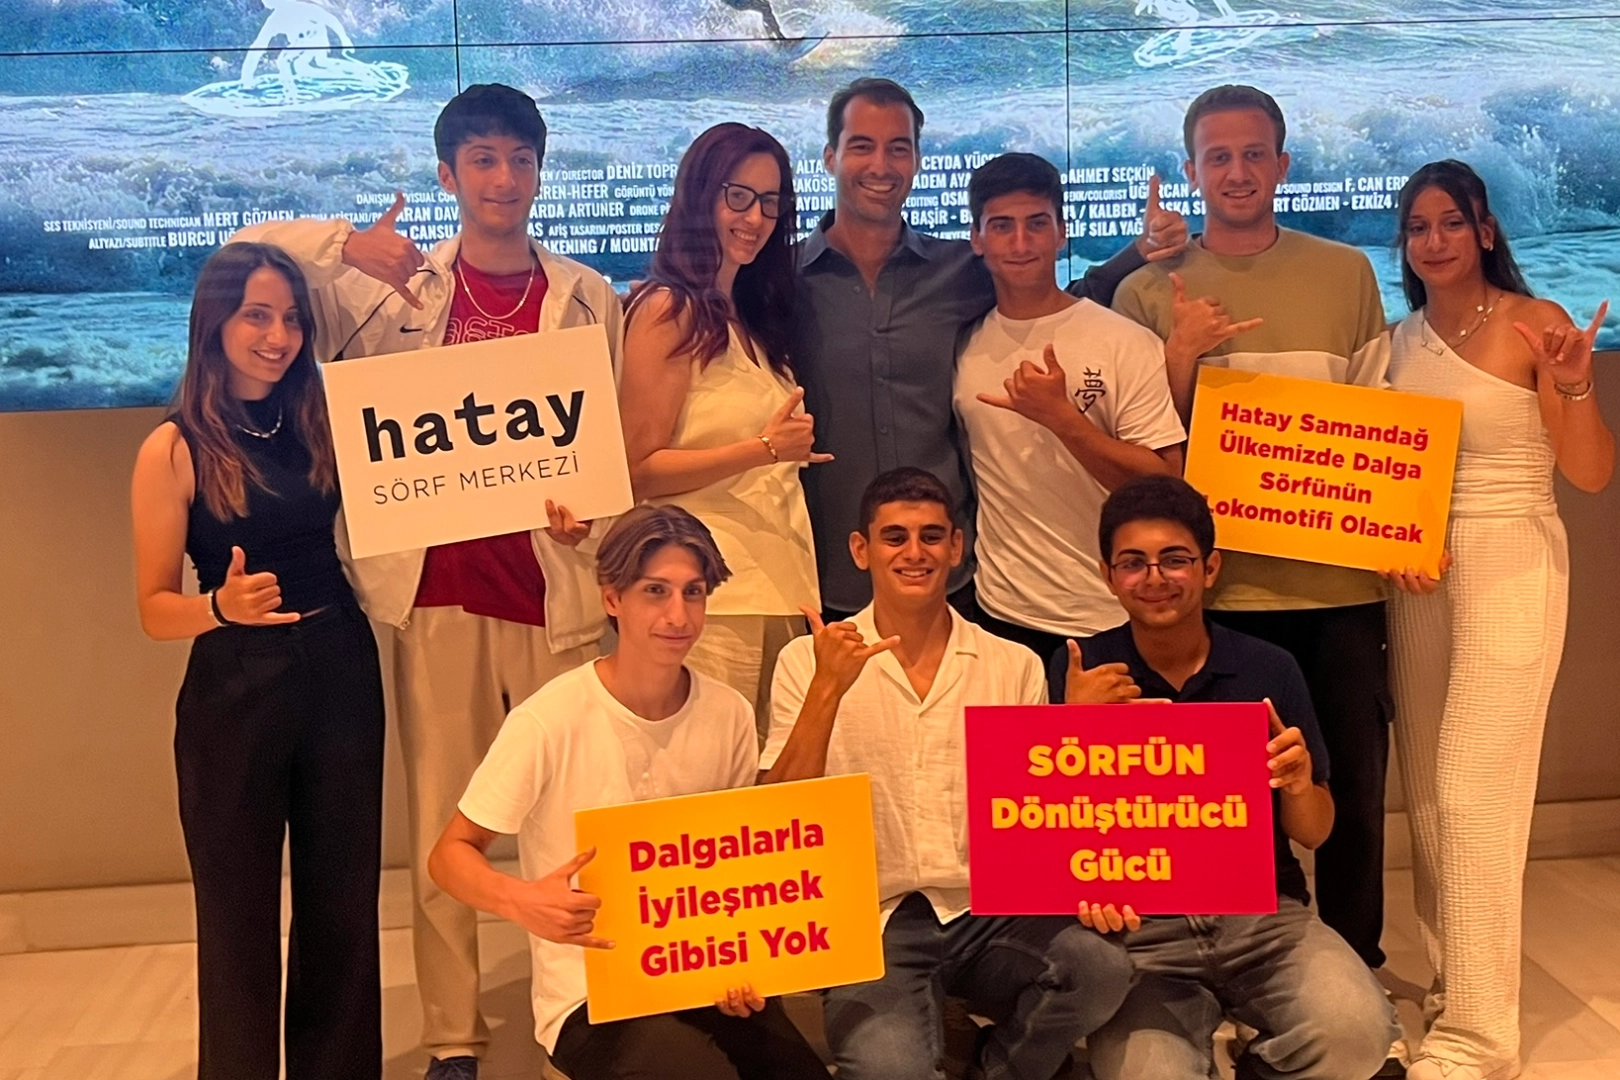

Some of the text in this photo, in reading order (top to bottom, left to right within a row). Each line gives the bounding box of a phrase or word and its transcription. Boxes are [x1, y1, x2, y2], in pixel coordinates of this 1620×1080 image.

[561, 169, 604, 181] DIRECTOR
[606, 161, 644, 180] DENİZ
[921, 154, 962, 170] CEYDA
[614, 184, 656, 199] GÖRÜNTÜ
[911, 172, 947, 190] ADEM
[1111, 163, 1156, 186] SEÇKİN
[43, 220, 62, 232] SES
[62, 216, 147, 232] TEKNİSYENİ/SOUND
[149, 215, 202, 229] TECHNICIAN
[202, 211, 239, 228] MERT
[529, 203, 565, 219] ARDA
[568, 202, 625, 218] ARTUNER
[629, 204, 659, 217] DRONE
[796, 195, 834, 213] AYDIN
[1312, 181, 1343, 194] DESIGN
[1357, 176, 1384, 192] CAN
[88, 235, 167, 250] ALTYAZI/SUBTITLE
[167, 230, 216, 248] BURCU
[409, 223, 455, 241] CANSU
[548, 222, 568, 239] AFİŞ
[569, 222, 643, 237] TASARIM/POSTER
[910, 206, 949, 229] BAŞİR
[1088, 202, 1137, 220] KALBEN
[1291, 193, 1340, 212] GÖZMEN
[1088, 221, 1118, 237] SILA
[362, 390, 585, 463] hatay
[1220, 402, 1429, 452] Hatay Samandağ
[373, 450, 579, 505] SÖRF MERKEZİ
[1219, 429, 1422, 480] Ülkemizde Dalga
[1259, 471, 1373, 504] Sörfünün
[1340, 515, 1423, 544] Olacak
[1027, 736, 1205, 777] SÖRFÜN
[991, 794, 1247, 834] Dönüştürücü
[629, 818, 824, 873] Dalgalarla
[1070, 848, 1171, 881] Gücü
[639, 869, 824, 929] İyileşmek
[640, 921, 831, 977] Gibisi Yok
